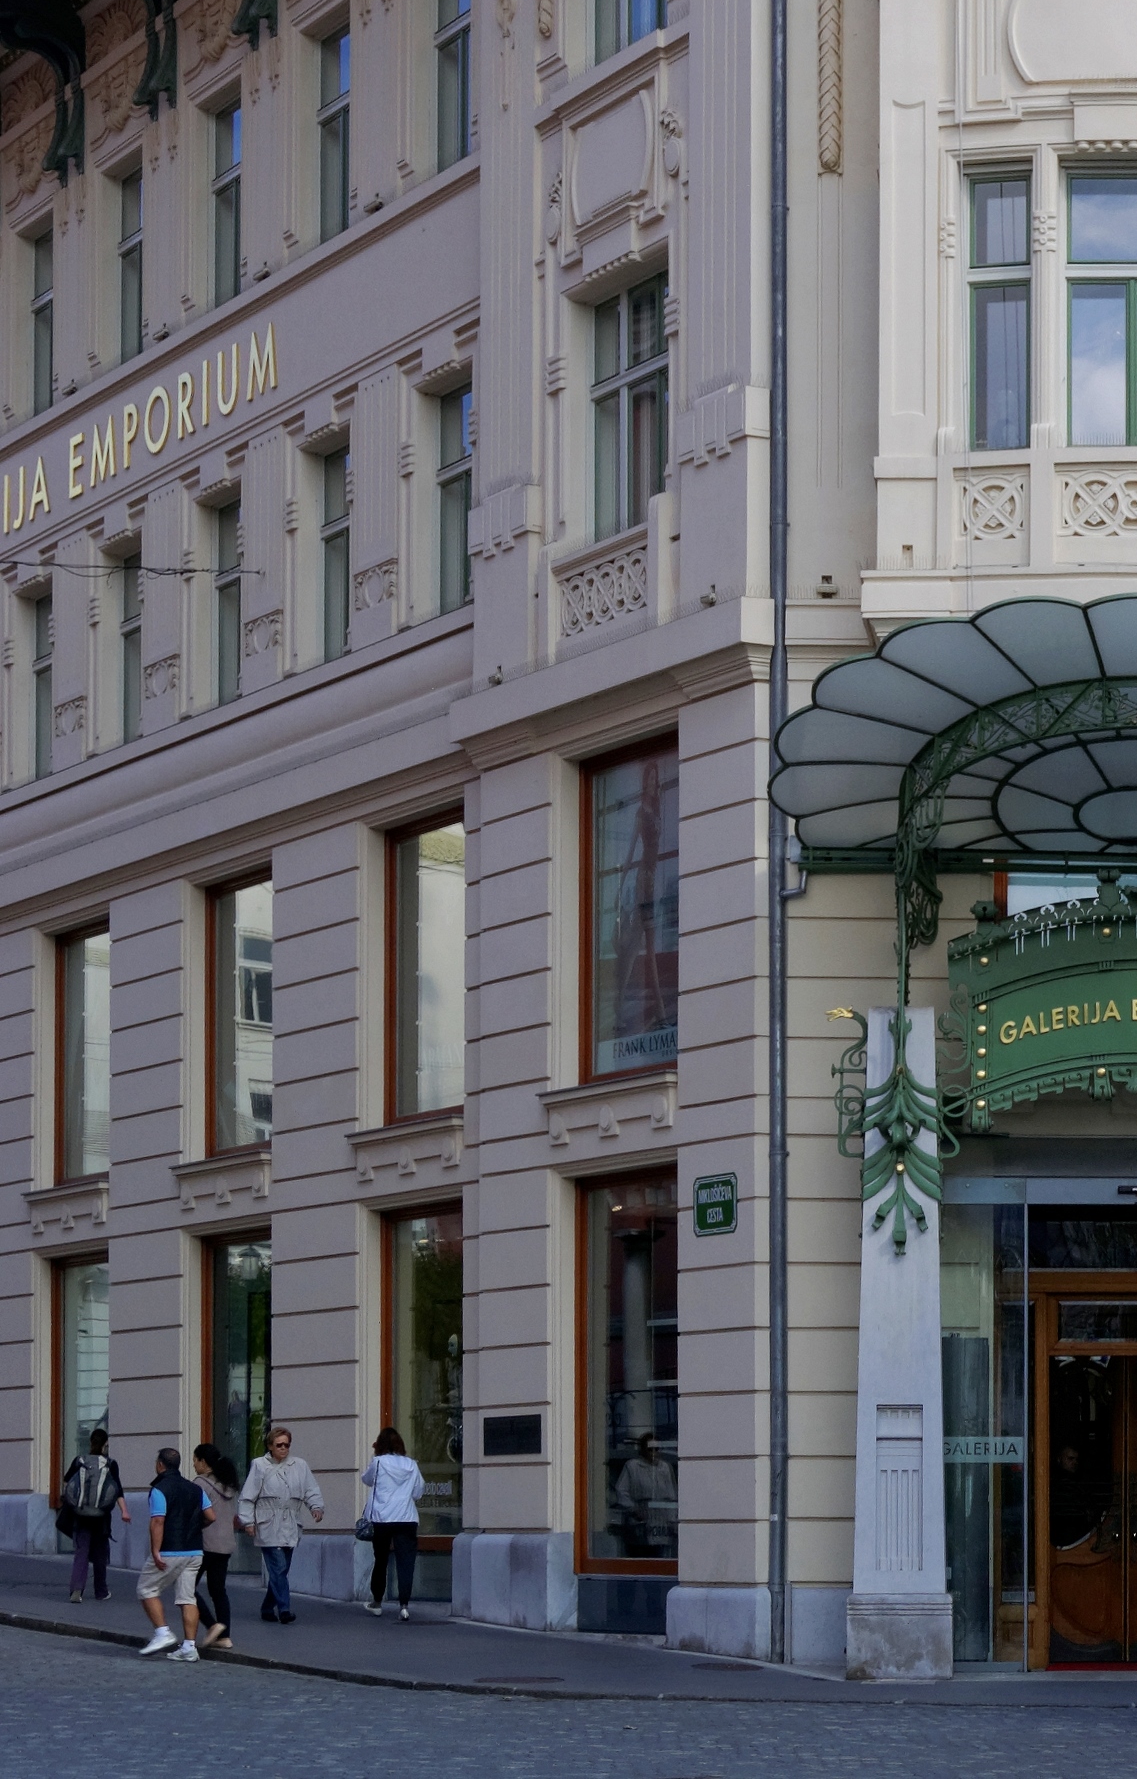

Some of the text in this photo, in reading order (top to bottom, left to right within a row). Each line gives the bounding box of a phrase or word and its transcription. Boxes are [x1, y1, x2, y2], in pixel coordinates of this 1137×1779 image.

[67, 321, 280, 499] EMPORIUM
[999, 1000, 1122, 1045] GALERIJA
[612, 1037, 647, 1059] FRANK
[706, 1207, 724, 1224] CESTA
